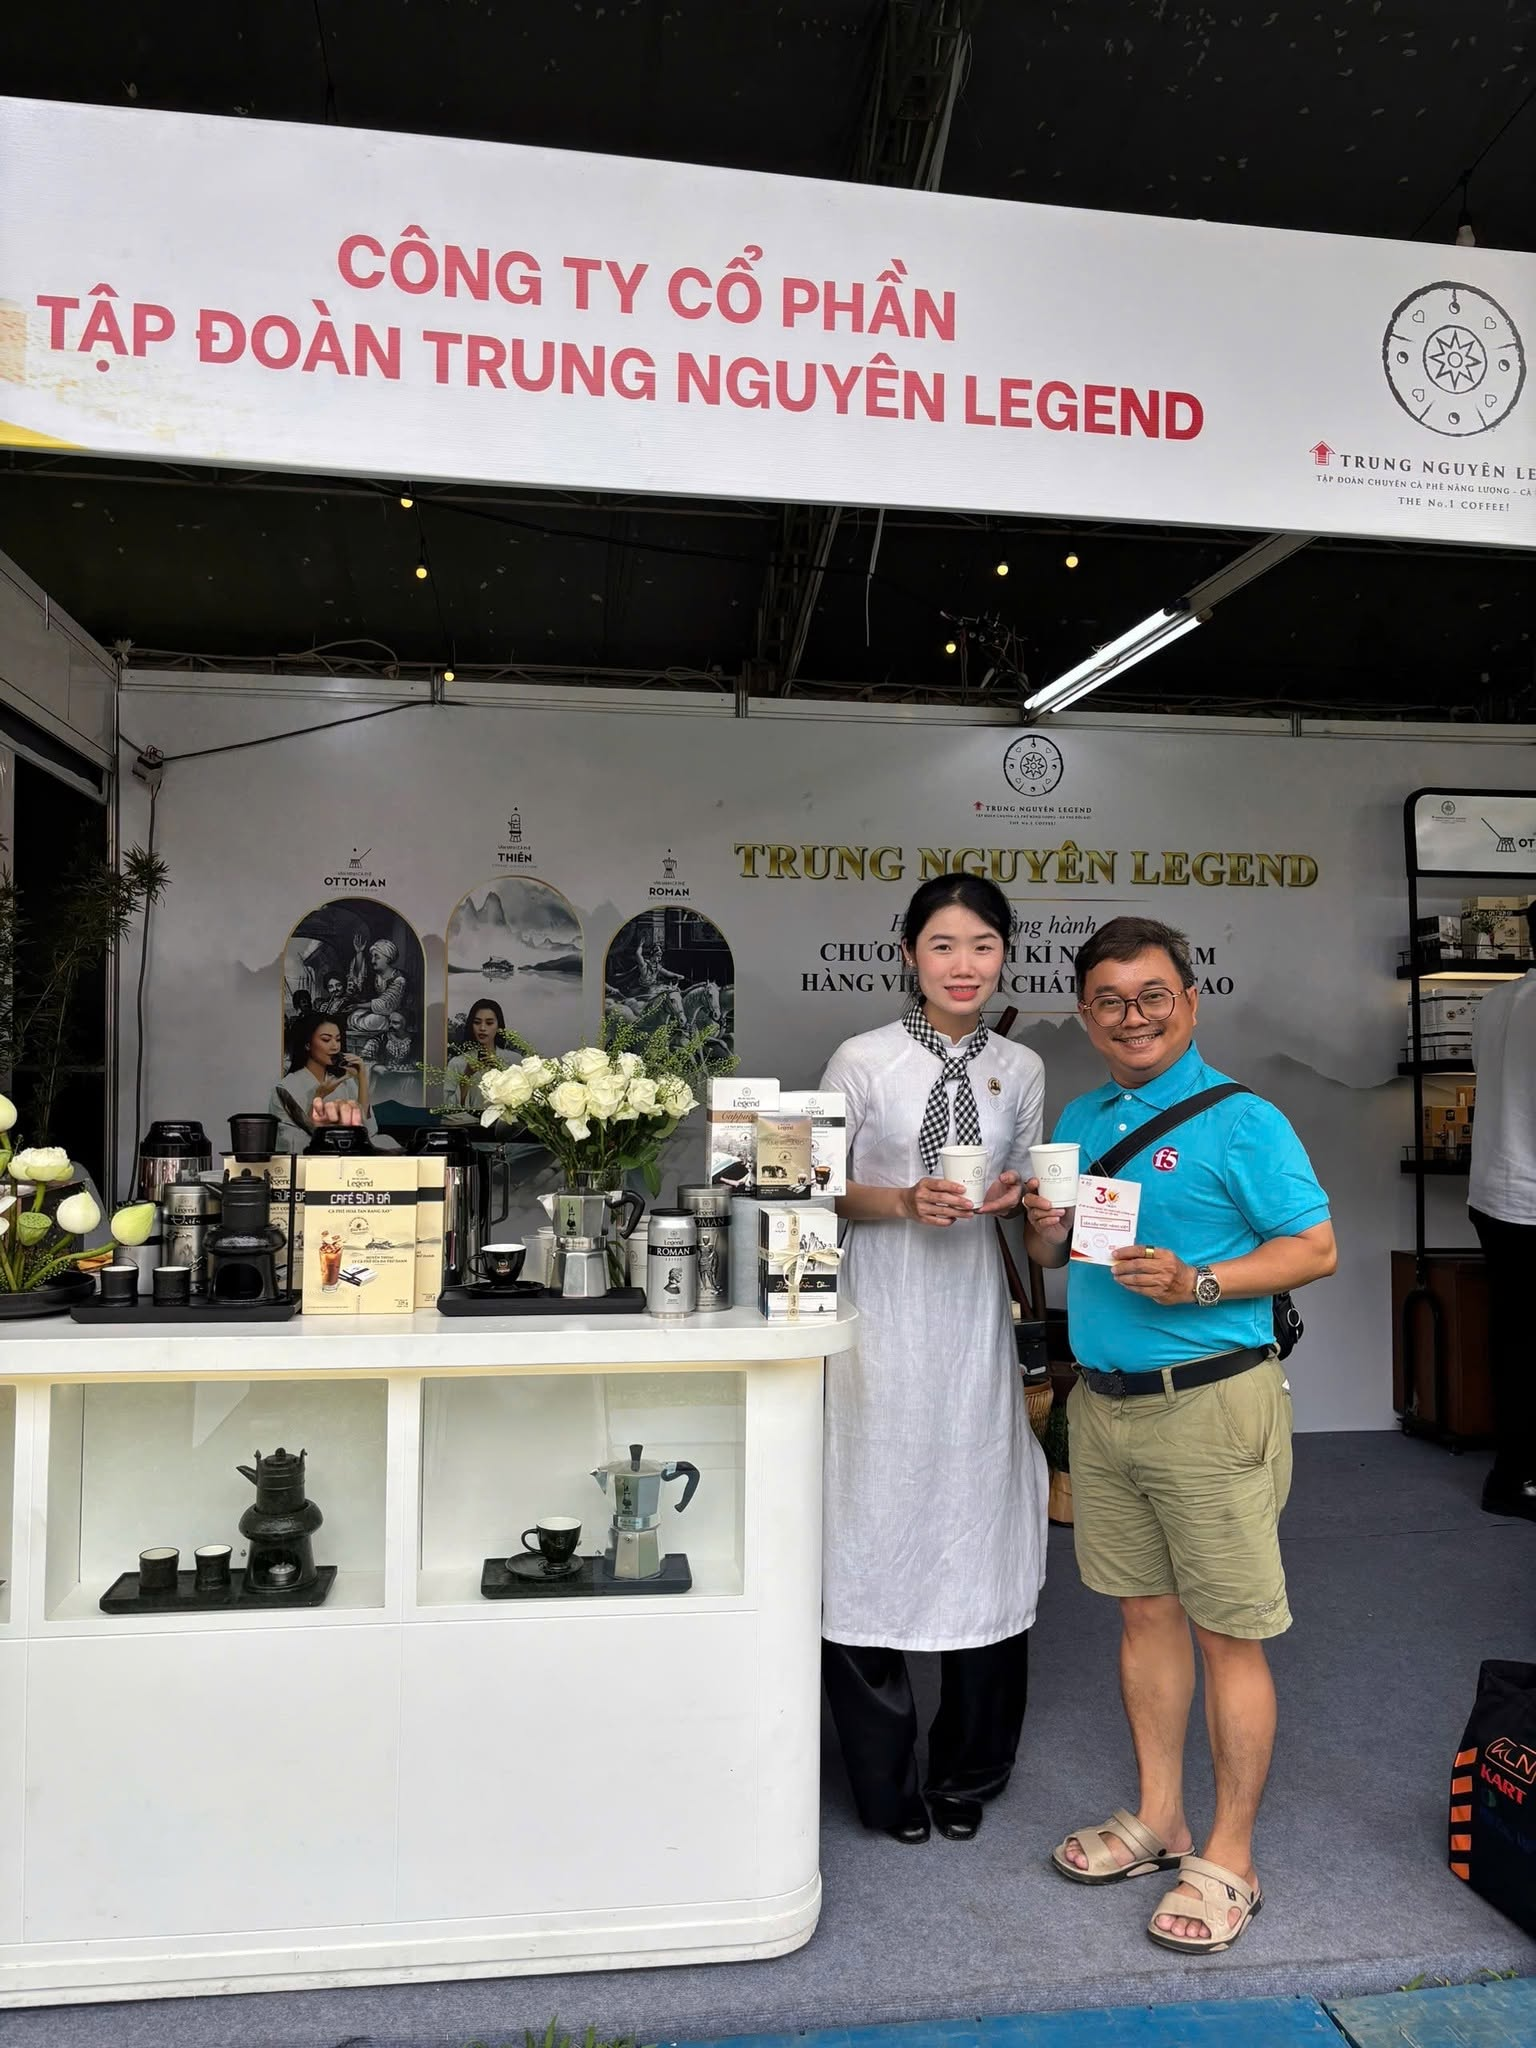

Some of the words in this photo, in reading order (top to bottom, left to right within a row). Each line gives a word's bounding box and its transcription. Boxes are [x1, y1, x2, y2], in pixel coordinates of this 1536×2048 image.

[337, 224, 542, 306] CÔNG
[563, 256, 649, 314] TY
[668, 244, 764, 324] CỔ
[782, 258, 956, 341] PHẦN
[36, 282, 176, 373] TẬP
[195, 299, 401, 380] ĐOÀN
[422, 330, 657, 401] TRUNG
[678, 352, 945, 423] NGUYÊN
[965, 375, 1204, 442] LEGEND
[1340, 454, 1412, 472] TRUNG
[1422, 461, 1505, 478] NGUYÊN
[1398, 496, 1421, 506] THE
[1428, 498, 1454, 508] No.1
[1461, 501, 1510, 512] COFFEE!
[734, 843, 905, 882] TRUNG
[917, 839, 1118, 884] NGUYÊN
[1130, 850, 1319, 888] LEGEND
[324, 876, 386, 888] OTTOMAN
[649, 887, 690, 896] ROMAN
[1048, 914, 1096, 934] hành
[1025, 939, 1052, 963] KỈ
[801, 968, 874, 992] HÀNG
[1011, 969, 1077, 994] CHẤT
[733, 1099, 760, 1109] Legend
[1155, 1148, 1178, 1169] f5
[347, 1179, 374, 1188] Legend
[330, 1191, 354, 1204] CAFÉ
[656, 1247, 690, 1257] ROMAN
[663, 1239, 684, 1247] Legend
[1480, 1762, 1527, 1805] KART
